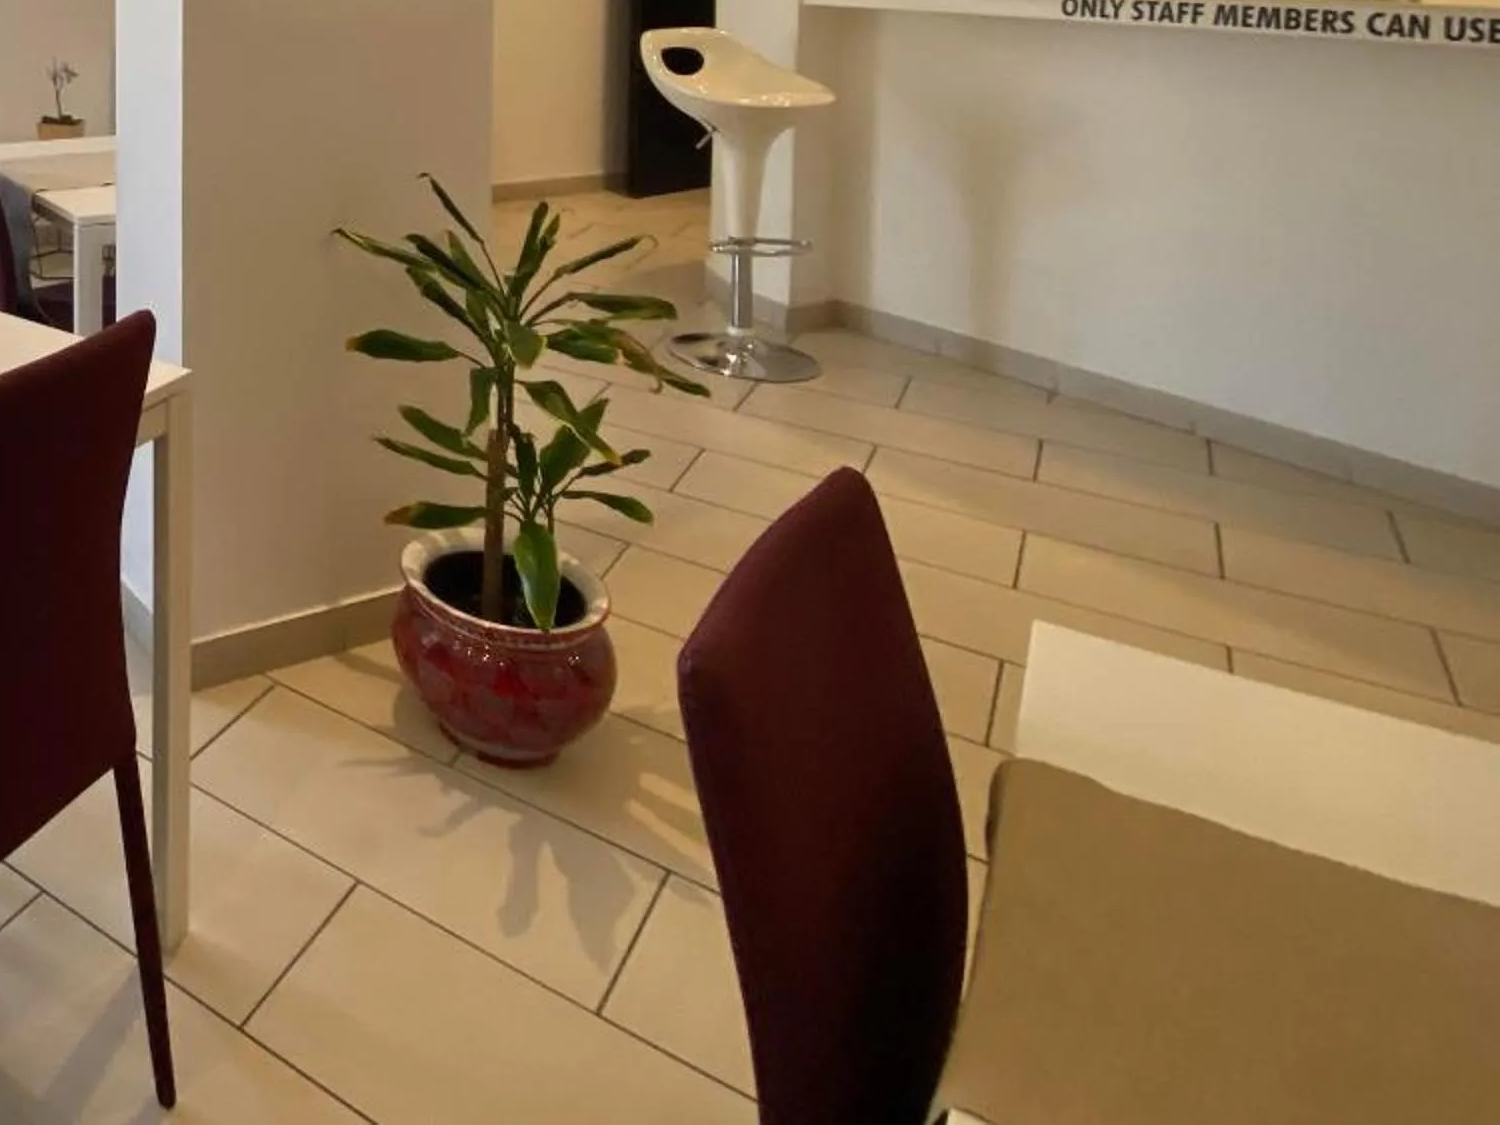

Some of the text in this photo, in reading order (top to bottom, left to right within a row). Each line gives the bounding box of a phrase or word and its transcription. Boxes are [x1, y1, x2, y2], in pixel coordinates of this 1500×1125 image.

[1131, 0, 1205, 24] STAFF
[1213, 3, 1355, 34] MEMBERS
[1366, 12, 1430, 40] CAN
[1444, 16, 1500, 44] USE
